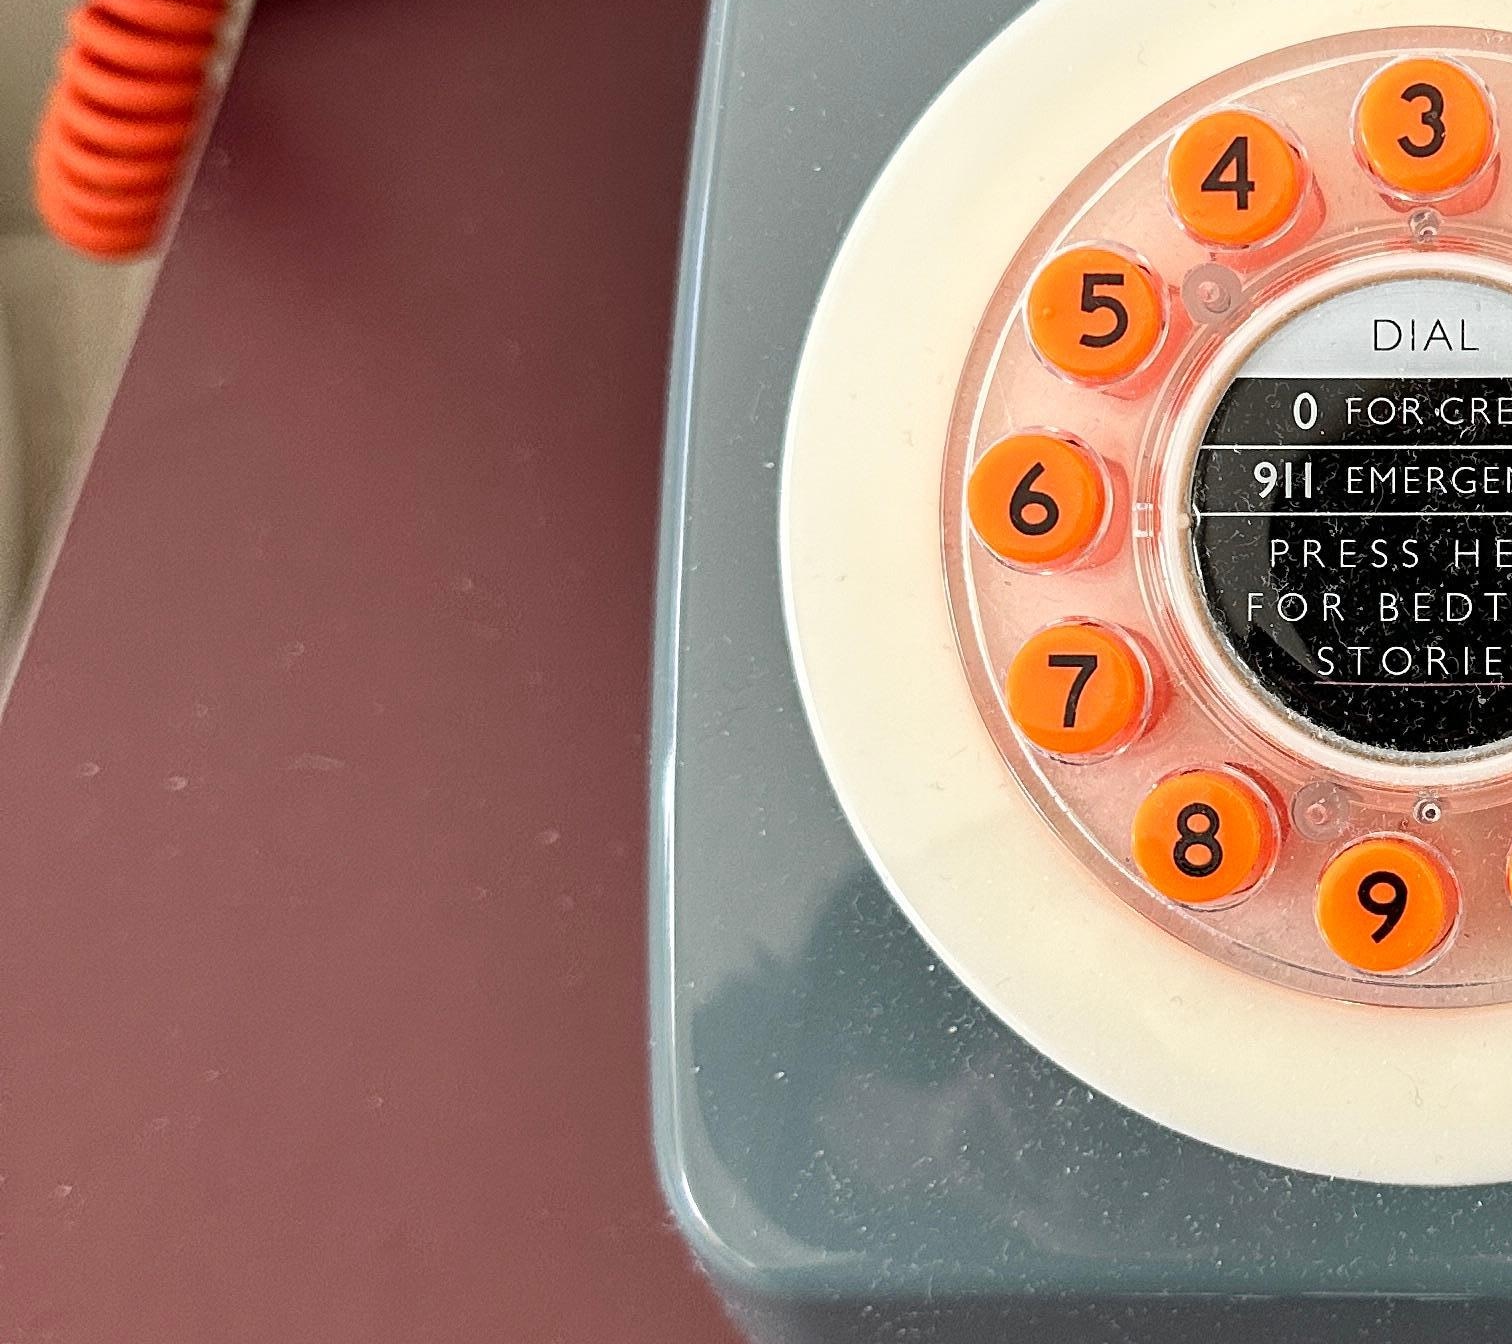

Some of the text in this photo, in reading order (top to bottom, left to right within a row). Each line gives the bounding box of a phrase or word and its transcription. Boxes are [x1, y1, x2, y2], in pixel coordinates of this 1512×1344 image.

[1398, 83, 1445, 157] 3
[1201, 137, 1255, 210] 4
[1080, 274, 1128, 348] 5
[1374, 319, 1479, 351] DIAL
[1294, 393, 1317, 429] 0
[1346, 398, 1423, 424] FOR
[1010, 463, 1059, 535] 6
[1254, 462, 1311, 498] 911
[1271, 539, 1418, 568] PRESS
[1248, 593, 1344, 621] FOR
[1048, 655, 1097, 727] 7
[1173, 803, 1223, 877] 8
[1358, 871, 1407, 943] 9
